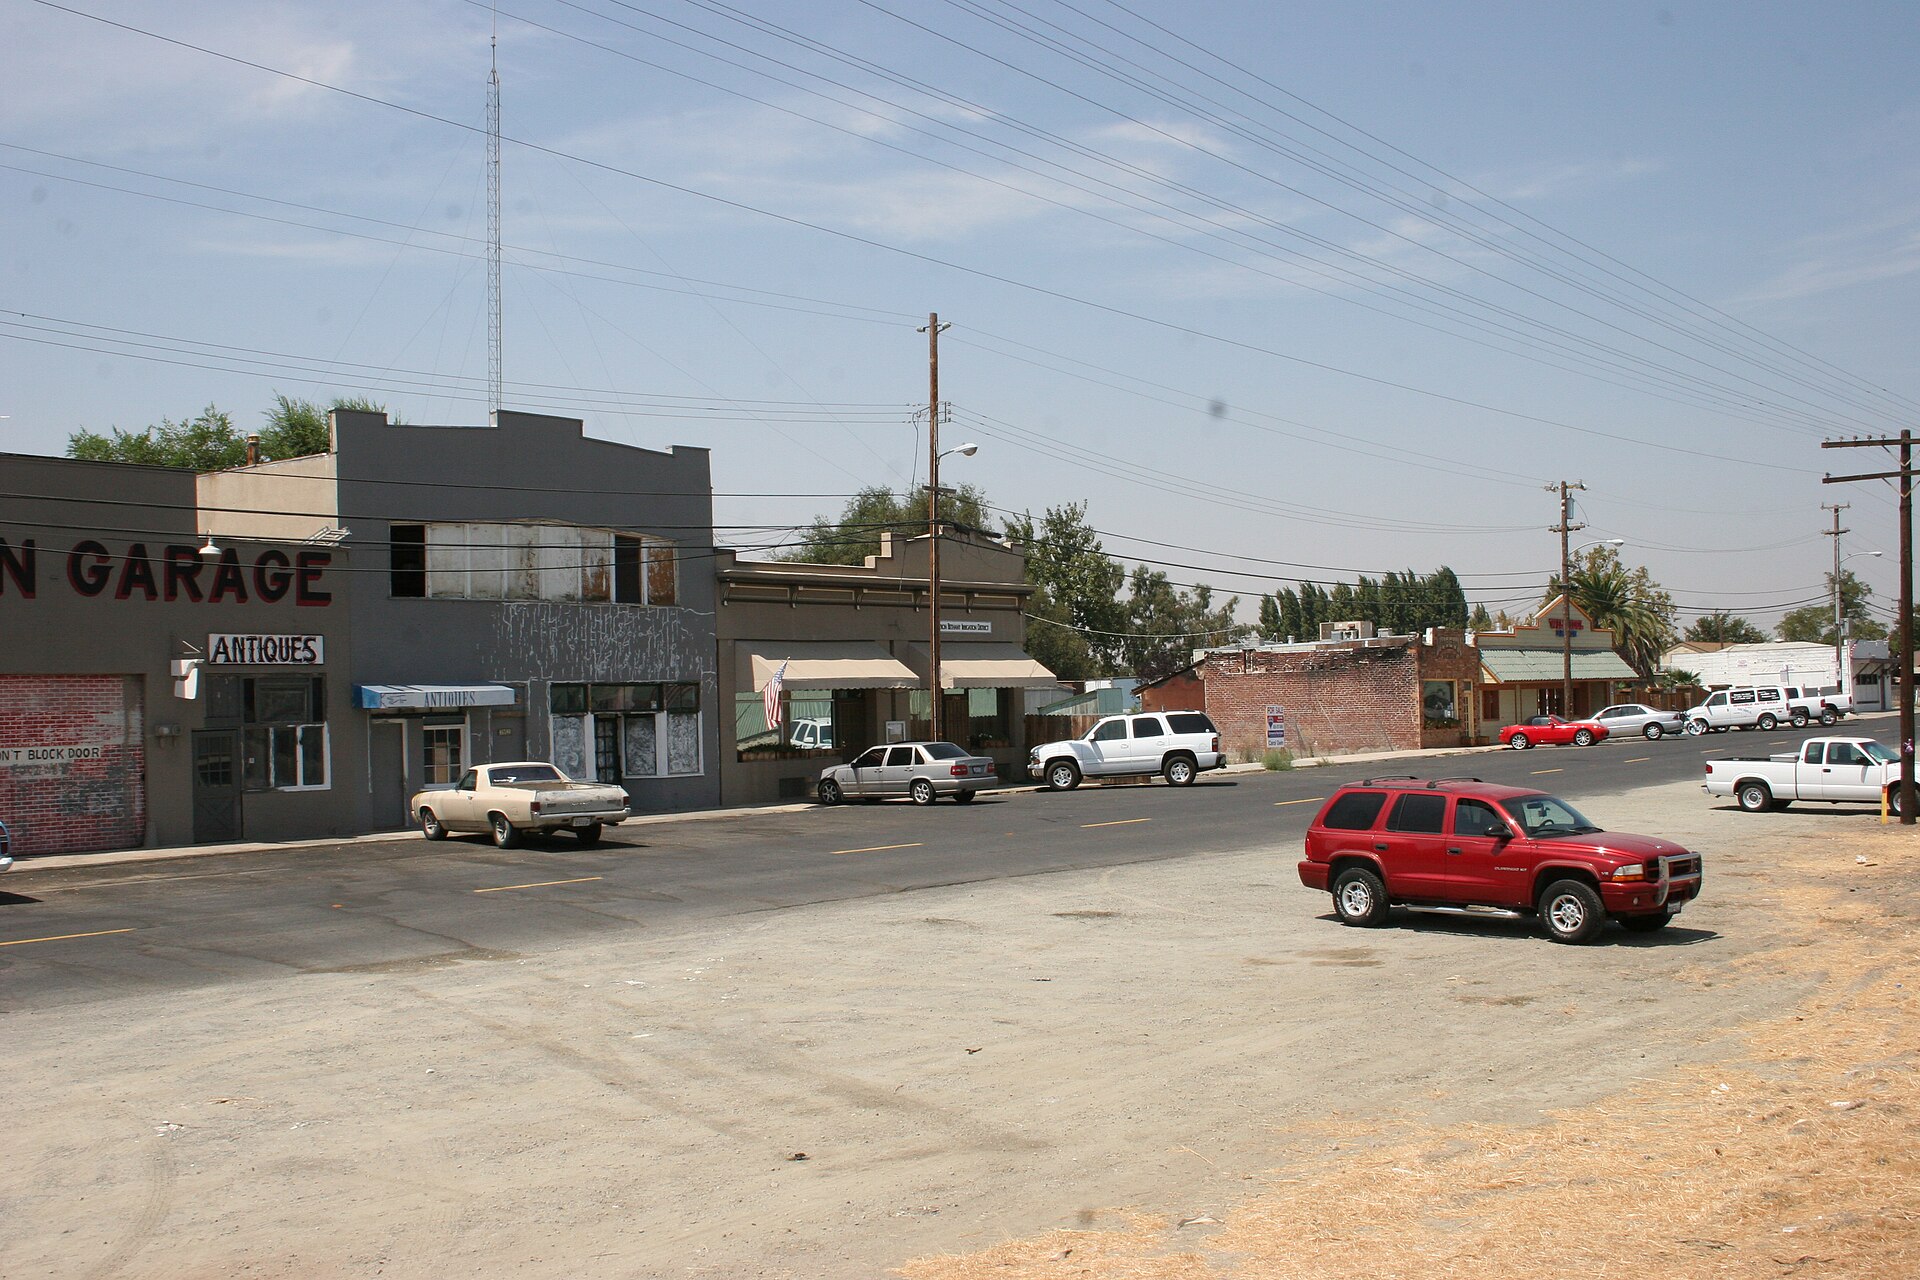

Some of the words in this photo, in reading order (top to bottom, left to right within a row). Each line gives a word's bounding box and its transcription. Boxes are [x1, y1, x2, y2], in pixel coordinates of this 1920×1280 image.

[66, 540, 332, 607] GARAGE
[210, 636, 318, 664] ANTIQUES
[424, 691, 476, 707] ANTIQUES
[0, 749, 22, 761] N'T
[28, 748, 65, 760] BLOCK
[68, 747, 100, 759] DOOR
